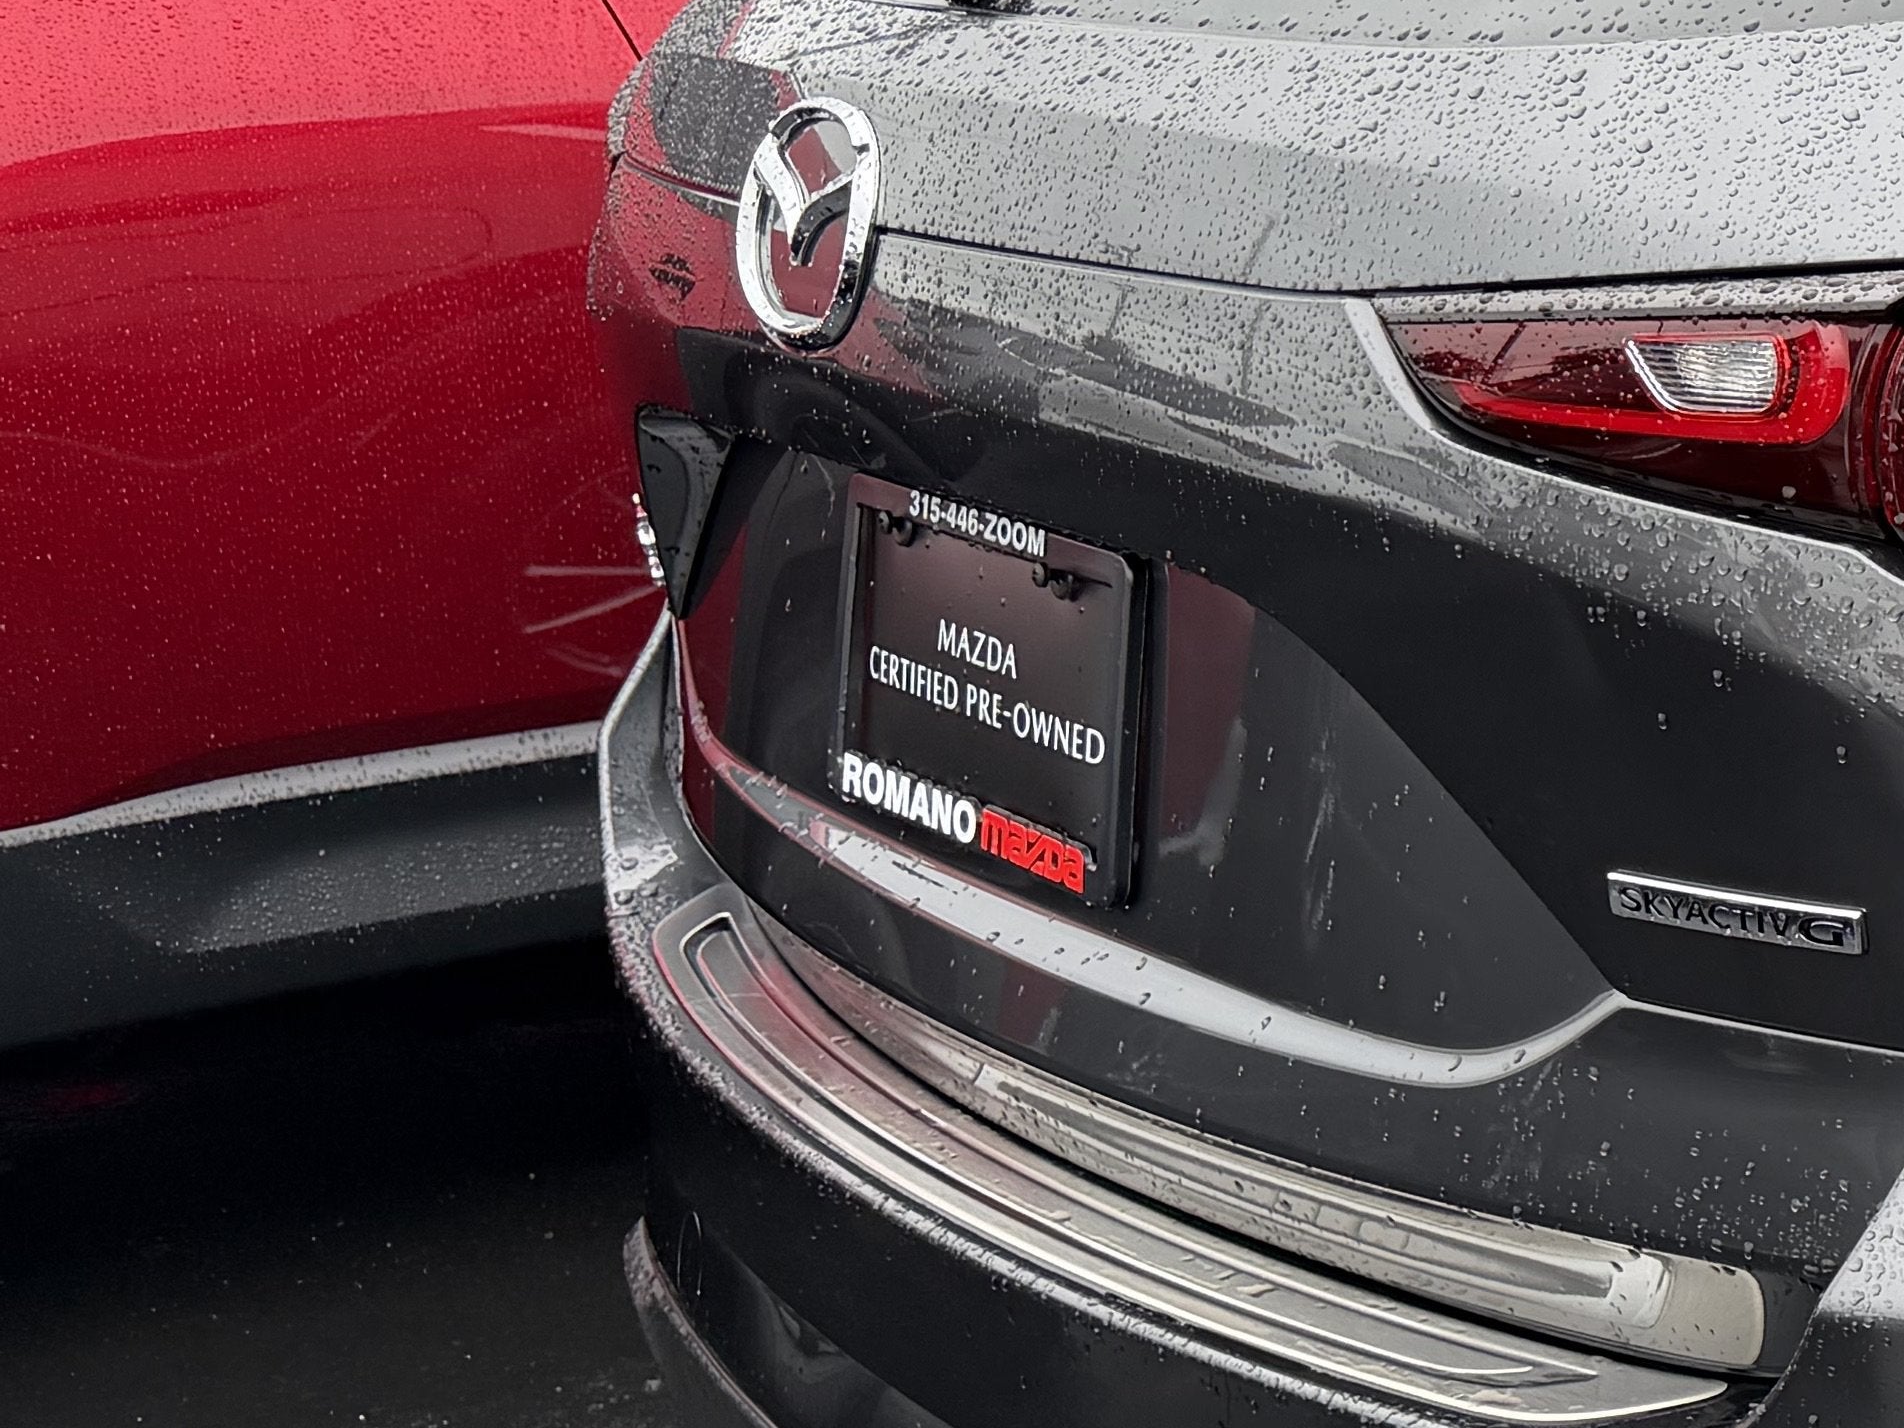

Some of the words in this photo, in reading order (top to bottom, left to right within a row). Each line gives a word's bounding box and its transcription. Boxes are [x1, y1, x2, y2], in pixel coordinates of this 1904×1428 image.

[909, 490, 1045, 557] 315-446-ZOOM
[937, 619, 1018, 679] MAZDA
[870, 646, 959, 711] CERTIFIED
[966, 684, 1106, 765] PRE-OWNED
[842, 752, 977, 844] ROMANO
